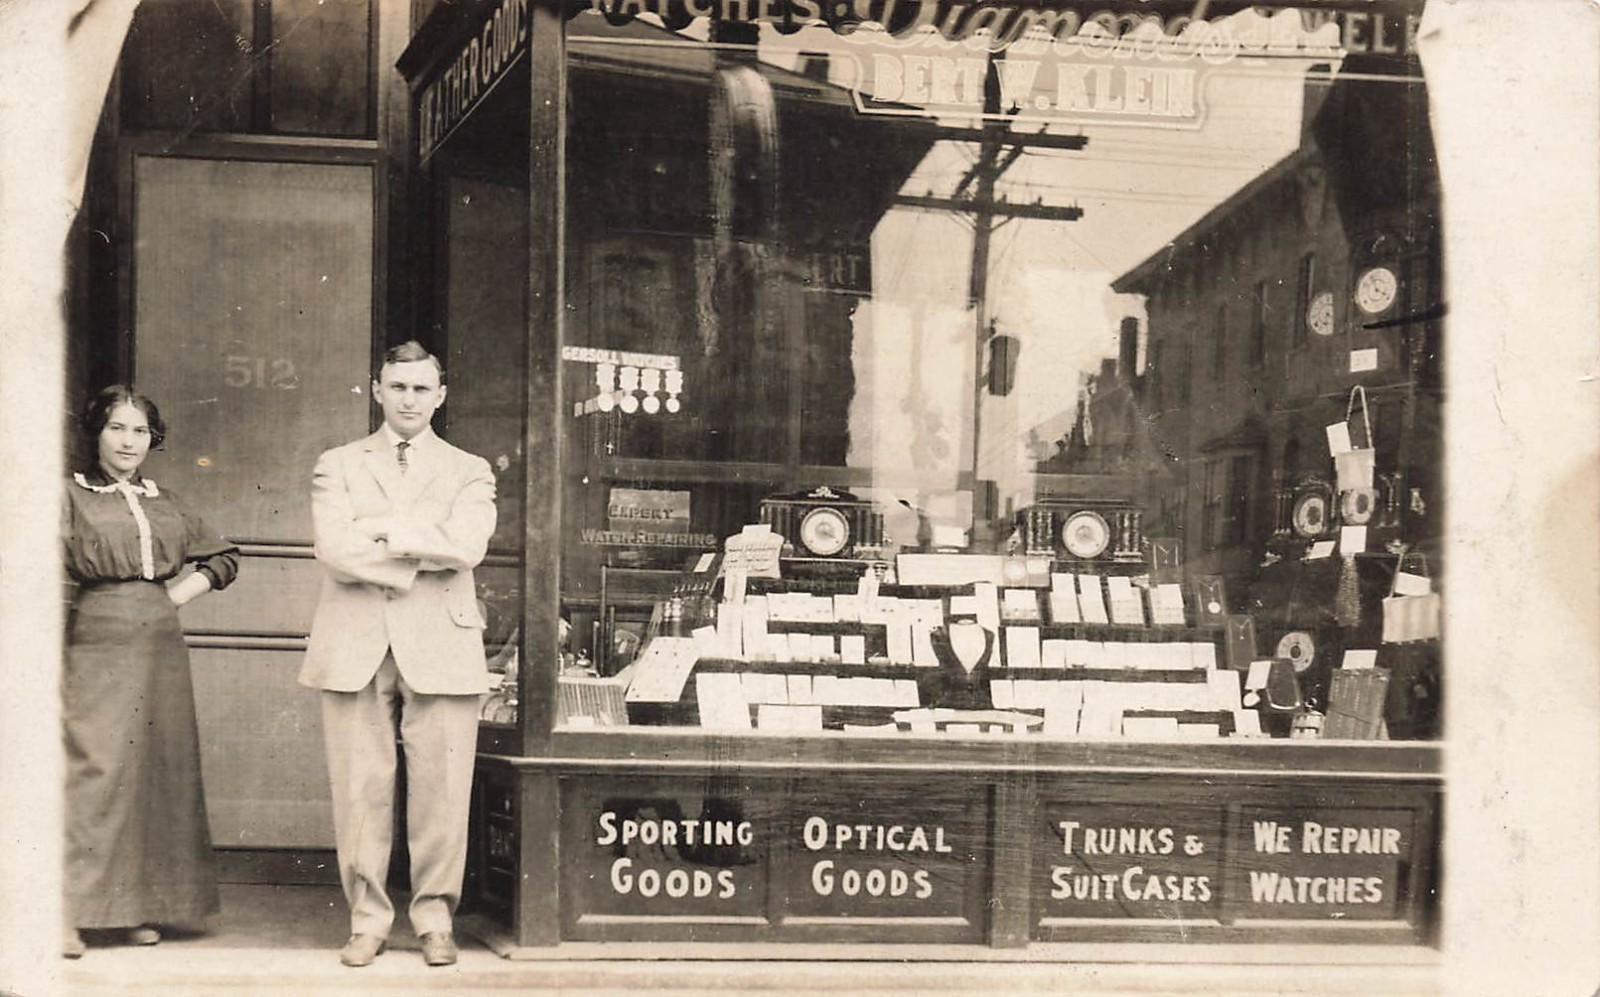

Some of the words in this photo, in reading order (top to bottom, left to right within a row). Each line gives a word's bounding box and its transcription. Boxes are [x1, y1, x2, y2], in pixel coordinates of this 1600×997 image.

[588, 0, 821, 24] CHES
[872, 53, 988, 105] BERT
[993, 59, 1051, 112] W.
[1055, 62, 1197, 116] KLEIN
[225, 356, 298, 390] 512
[597, 812, 753, 846] SPORTING
[803, 816, 952, 853] OPTICAL
[1059, 821, 1174, 855] TRUNKS
[1184, 834, 1204, 856] &
[1253, 821, 1293, 854] WE
[1302, 821, 1400, 854] REPAIR
[611, 857, 735, 899] GOODS
[812, 860, 933, 899] GOODS
[1051, 866, 1211, 902] SUITCASES
[1250, 871, 1383, 903] WATCHES
